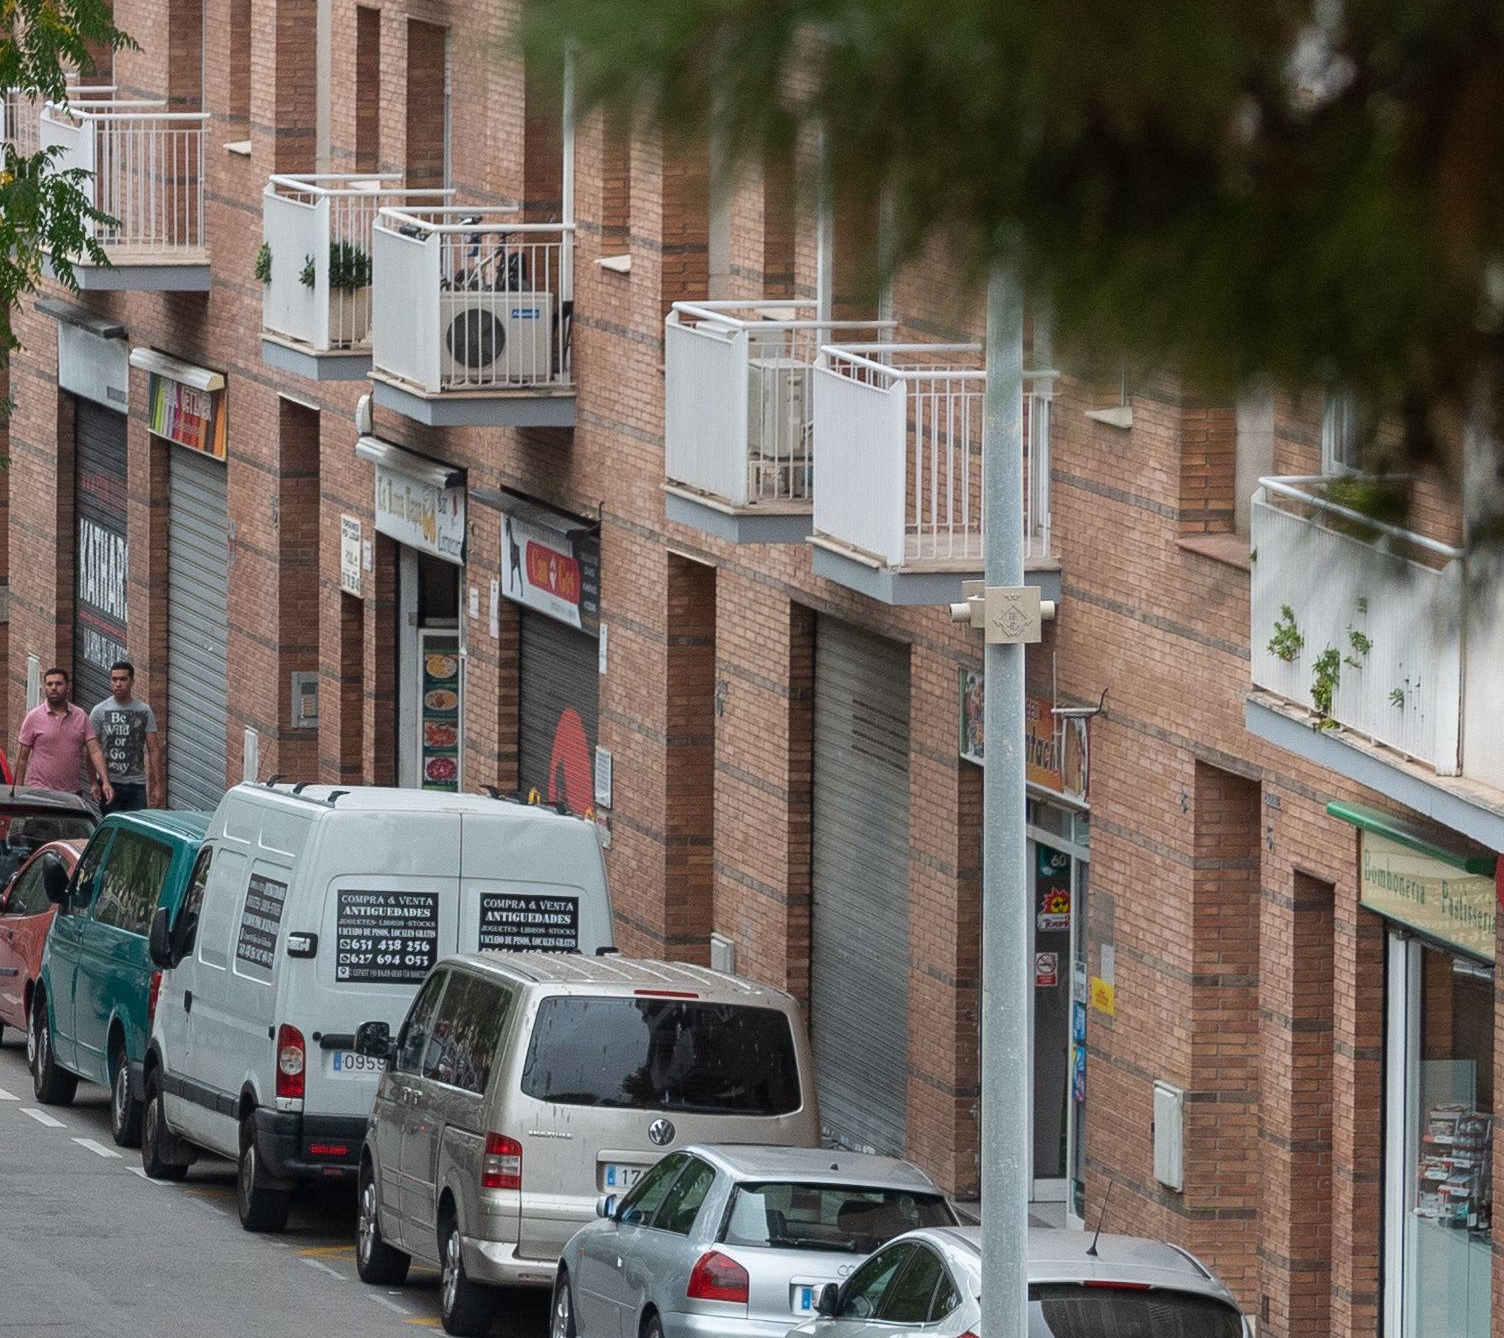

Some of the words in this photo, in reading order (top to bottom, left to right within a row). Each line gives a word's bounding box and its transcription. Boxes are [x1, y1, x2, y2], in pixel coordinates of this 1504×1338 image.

[112, 712, 127, 723] Be
[103, 724, 130, 736] Wild
[114, 738, 127, 747] or
[110, 748, 126, 760] Go
[341, 895, 385, 905] COMPRA
[388, 896, 396, 904] &
[399, 896, 434, 906] VENTA
[483, 898, 526, 910] COMPRA
[528, 901, 537, 910] &
[539, 900, 574, 912] VENTA
[343, 906, 431, 918] ANTIGUEDADES
[485, 911, 572, 925] ANTIGUEDADES
[351, 938, 373, 951] 631
[377, 939, 402, 952] 438
[406, 941, 430, 952] 256
[350, 953, 373, 965] 627
[376, 954, 401, 965] 694
[345, 1054, 385, 1071] 0959
[622, 1168, 646, 1186] 17
